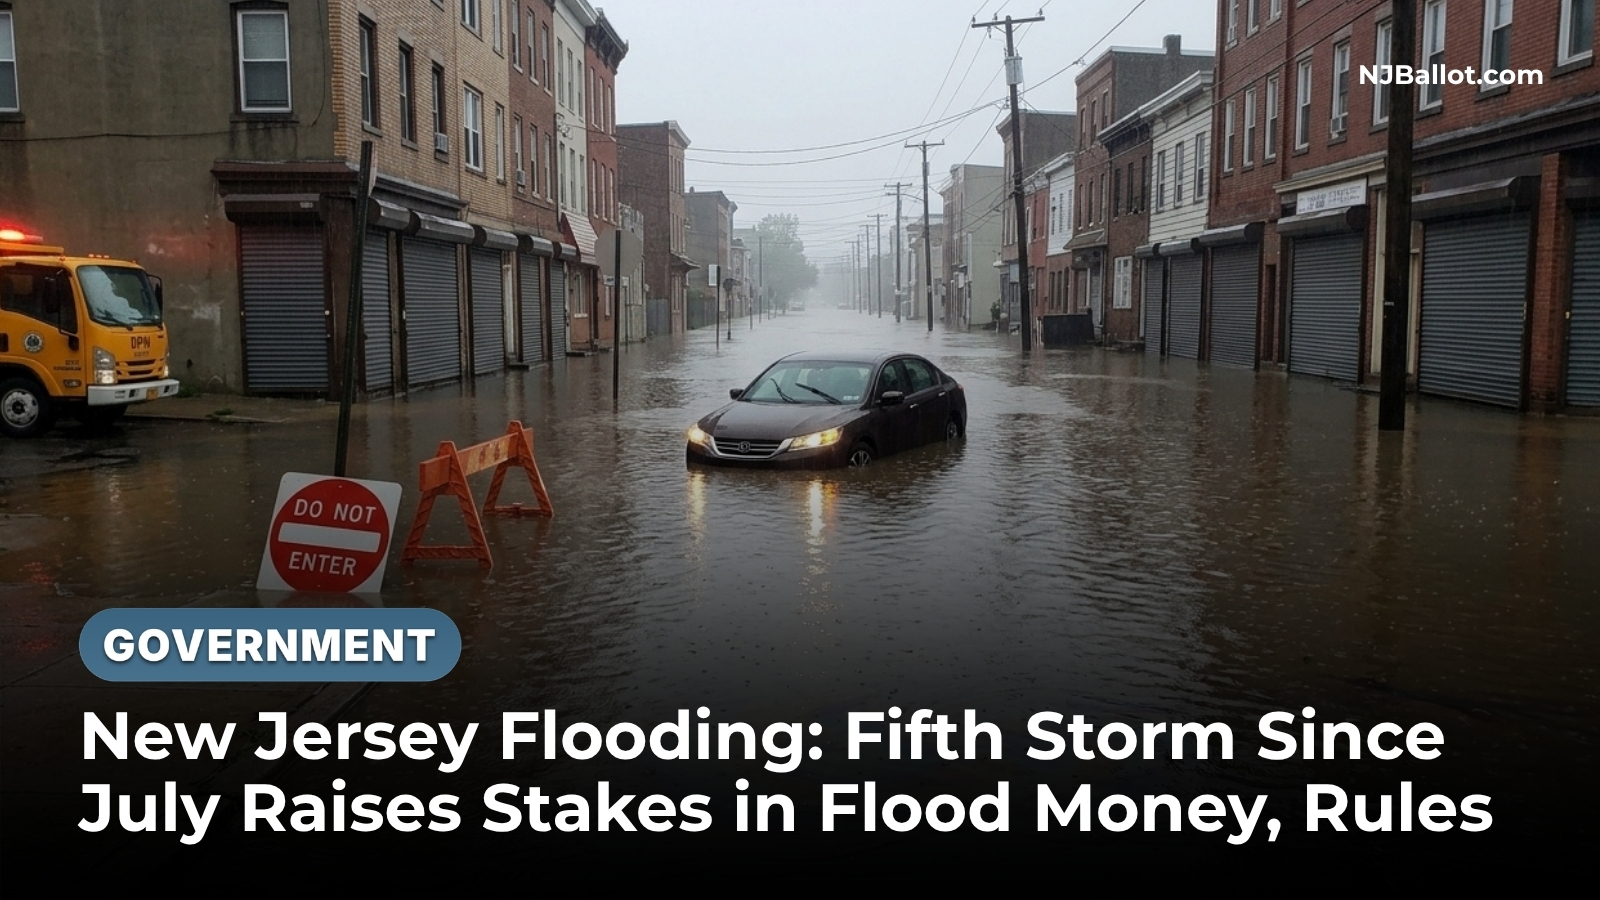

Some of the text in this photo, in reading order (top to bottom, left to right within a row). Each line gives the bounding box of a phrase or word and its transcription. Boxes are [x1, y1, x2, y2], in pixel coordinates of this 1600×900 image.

[293, 498, 377, 525] DO NOT
[288, 551, 357, 577] ENTER
